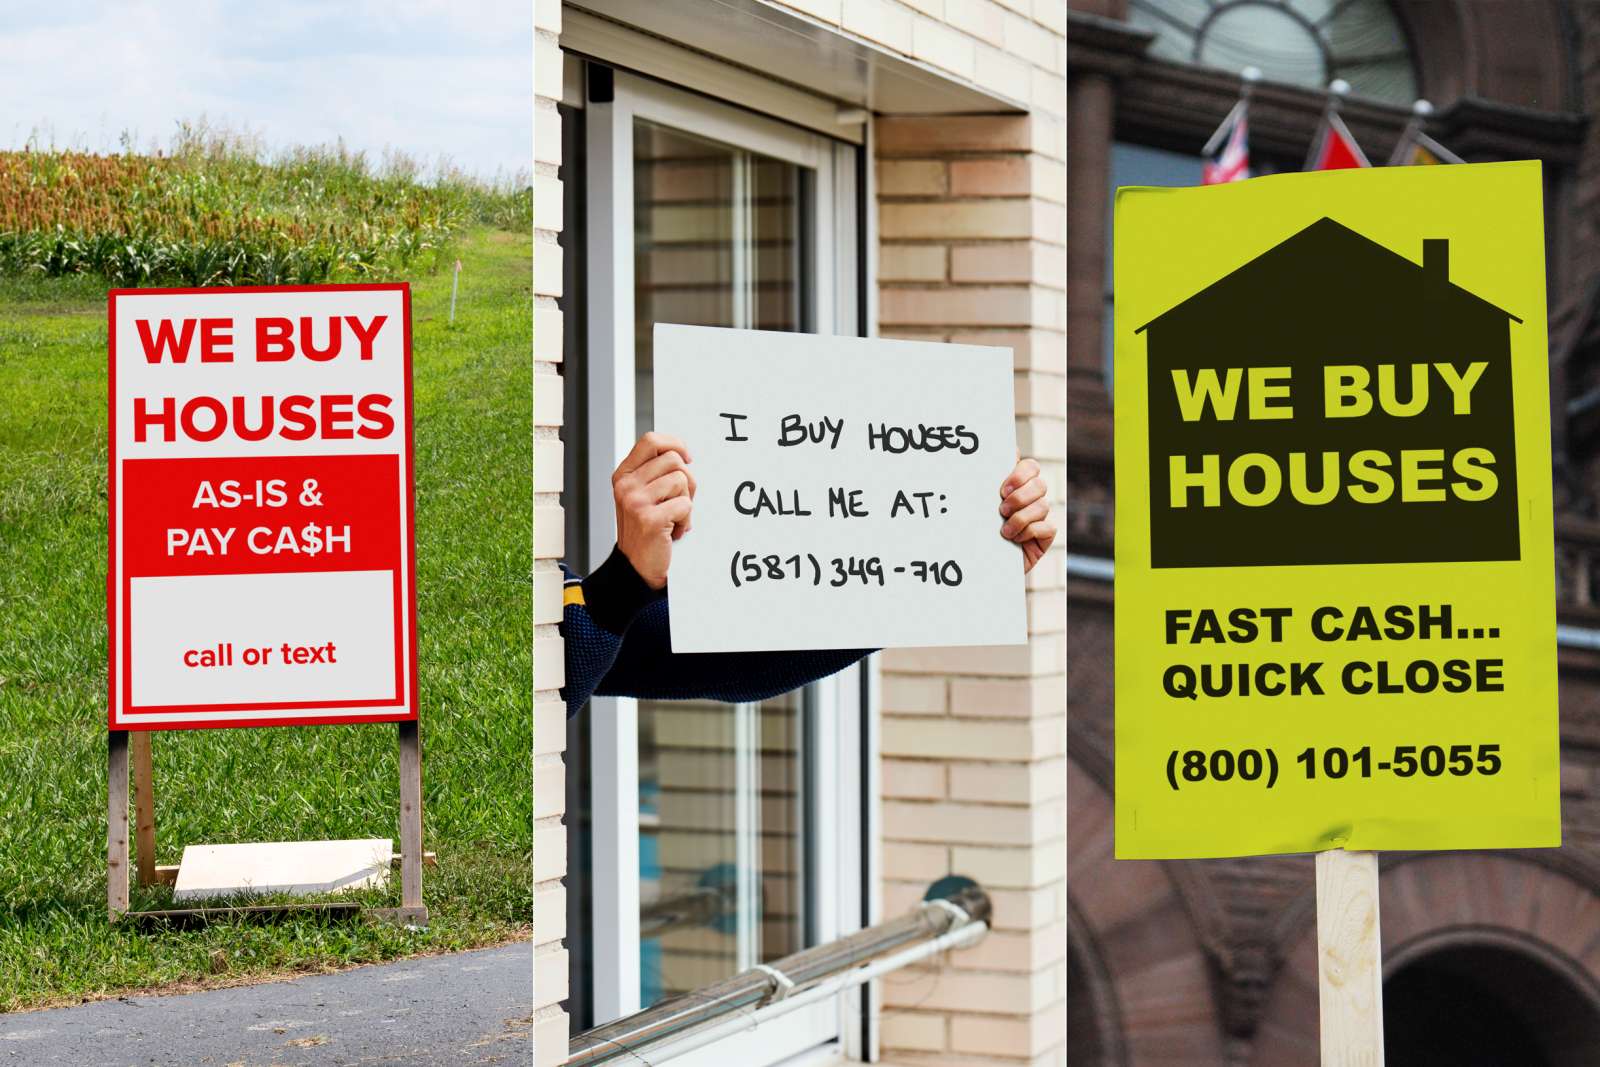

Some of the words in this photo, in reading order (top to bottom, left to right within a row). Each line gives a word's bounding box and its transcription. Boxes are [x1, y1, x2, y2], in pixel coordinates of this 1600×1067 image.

[135, 317, 234, 364] WE
[255, 314, 387, 362] BUY
[1170, 366, 1293, 421] WE
[1323, 361, 1488, 418] BUY
[133, 393, 394, 443] HOUSES
[719, 412, 748, 441] I
[777, 414, 843, 449] BUY
[868, 422, 978, 454] HOUSES
[192, 479, 287, 508] AS-IS
[299, 478, 323, 506] &
[1169, 447, 1498, 507] HOUSES
[733, 480, 811, 517] CALL
[828, 487, 868, 518] ME
[890, 490, 947, 518] AT:
[167, 527, 236, 555] PAY
[247, 521, 350, 556] CA$H
[1164, 607, 1292, 644] FAST
[1310, 603, 1500, 642] CASH...
[183, 642, 232, 667] call
[242, 647, 272, 666] or
[280, 641, 336, 664] text
[1162, 661, 1325, 701] QUICK
[1341, 658, 1504, 695] CLOSE
[1166, 748, 1278, 790] (800)
[1296, 743, 1501, 779] 101-5055
